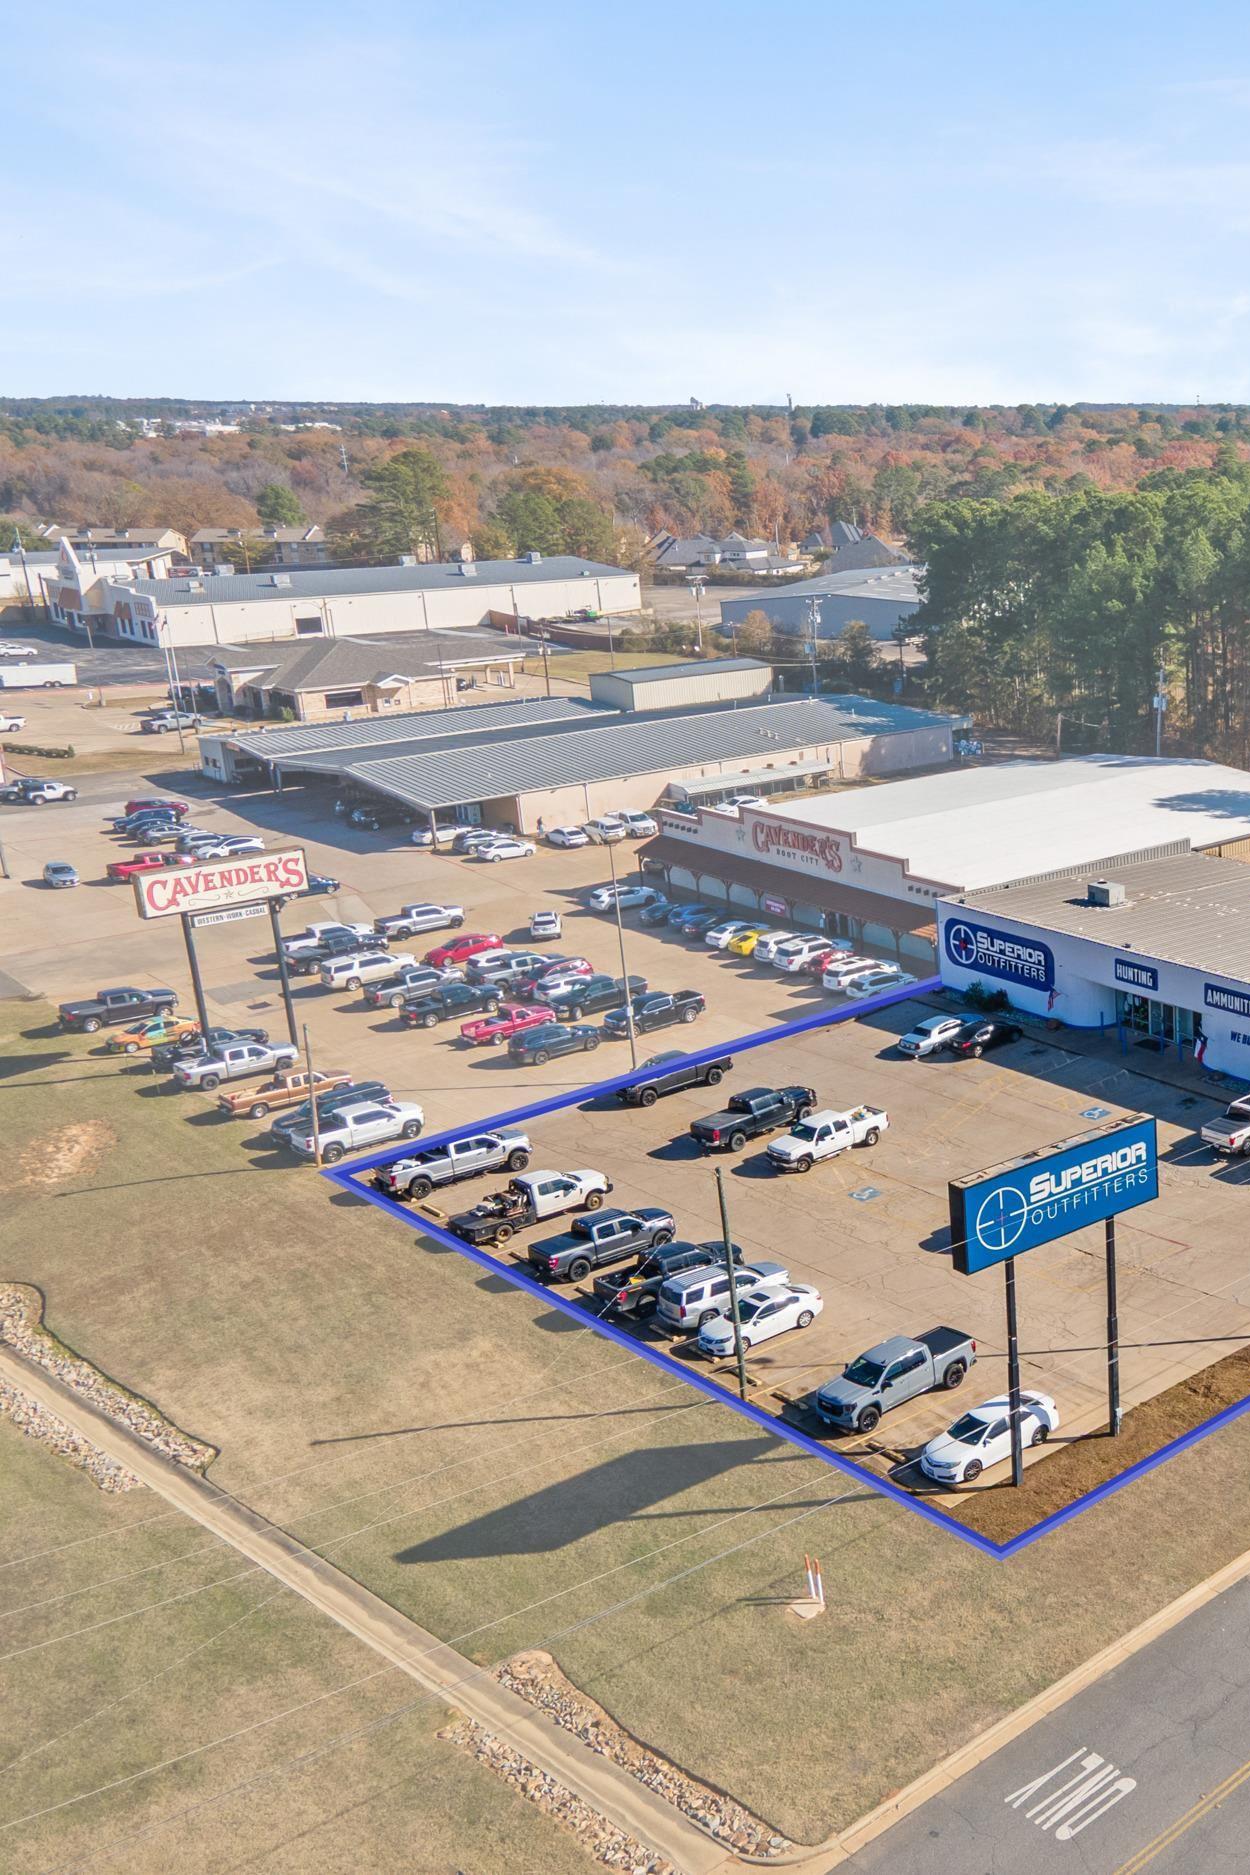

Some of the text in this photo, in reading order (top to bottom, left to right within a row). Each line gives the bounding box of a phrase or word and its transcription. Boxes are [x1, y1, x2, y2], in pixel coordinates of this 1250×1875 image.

[752, 821, 842, 873] CAVENDER'S
[776, 848, 819, 866] BOOT CITY
[146, 857, 304, 911] CAVENDER'S
[976, 931, 1045, 966] SUPERIOR
[977, 952, 1046, 982] OUTFITTERS
[1116, 963, 1153, 987] HUNTING
[1230, 1030, 1241, 1040] WE
[1029, 1141, 1147, 1203] SUPERIOR
[1031, 1168, 1148, 1225] OUTFITTERS
[1004, 1746, 1137, 1841] ONLY
